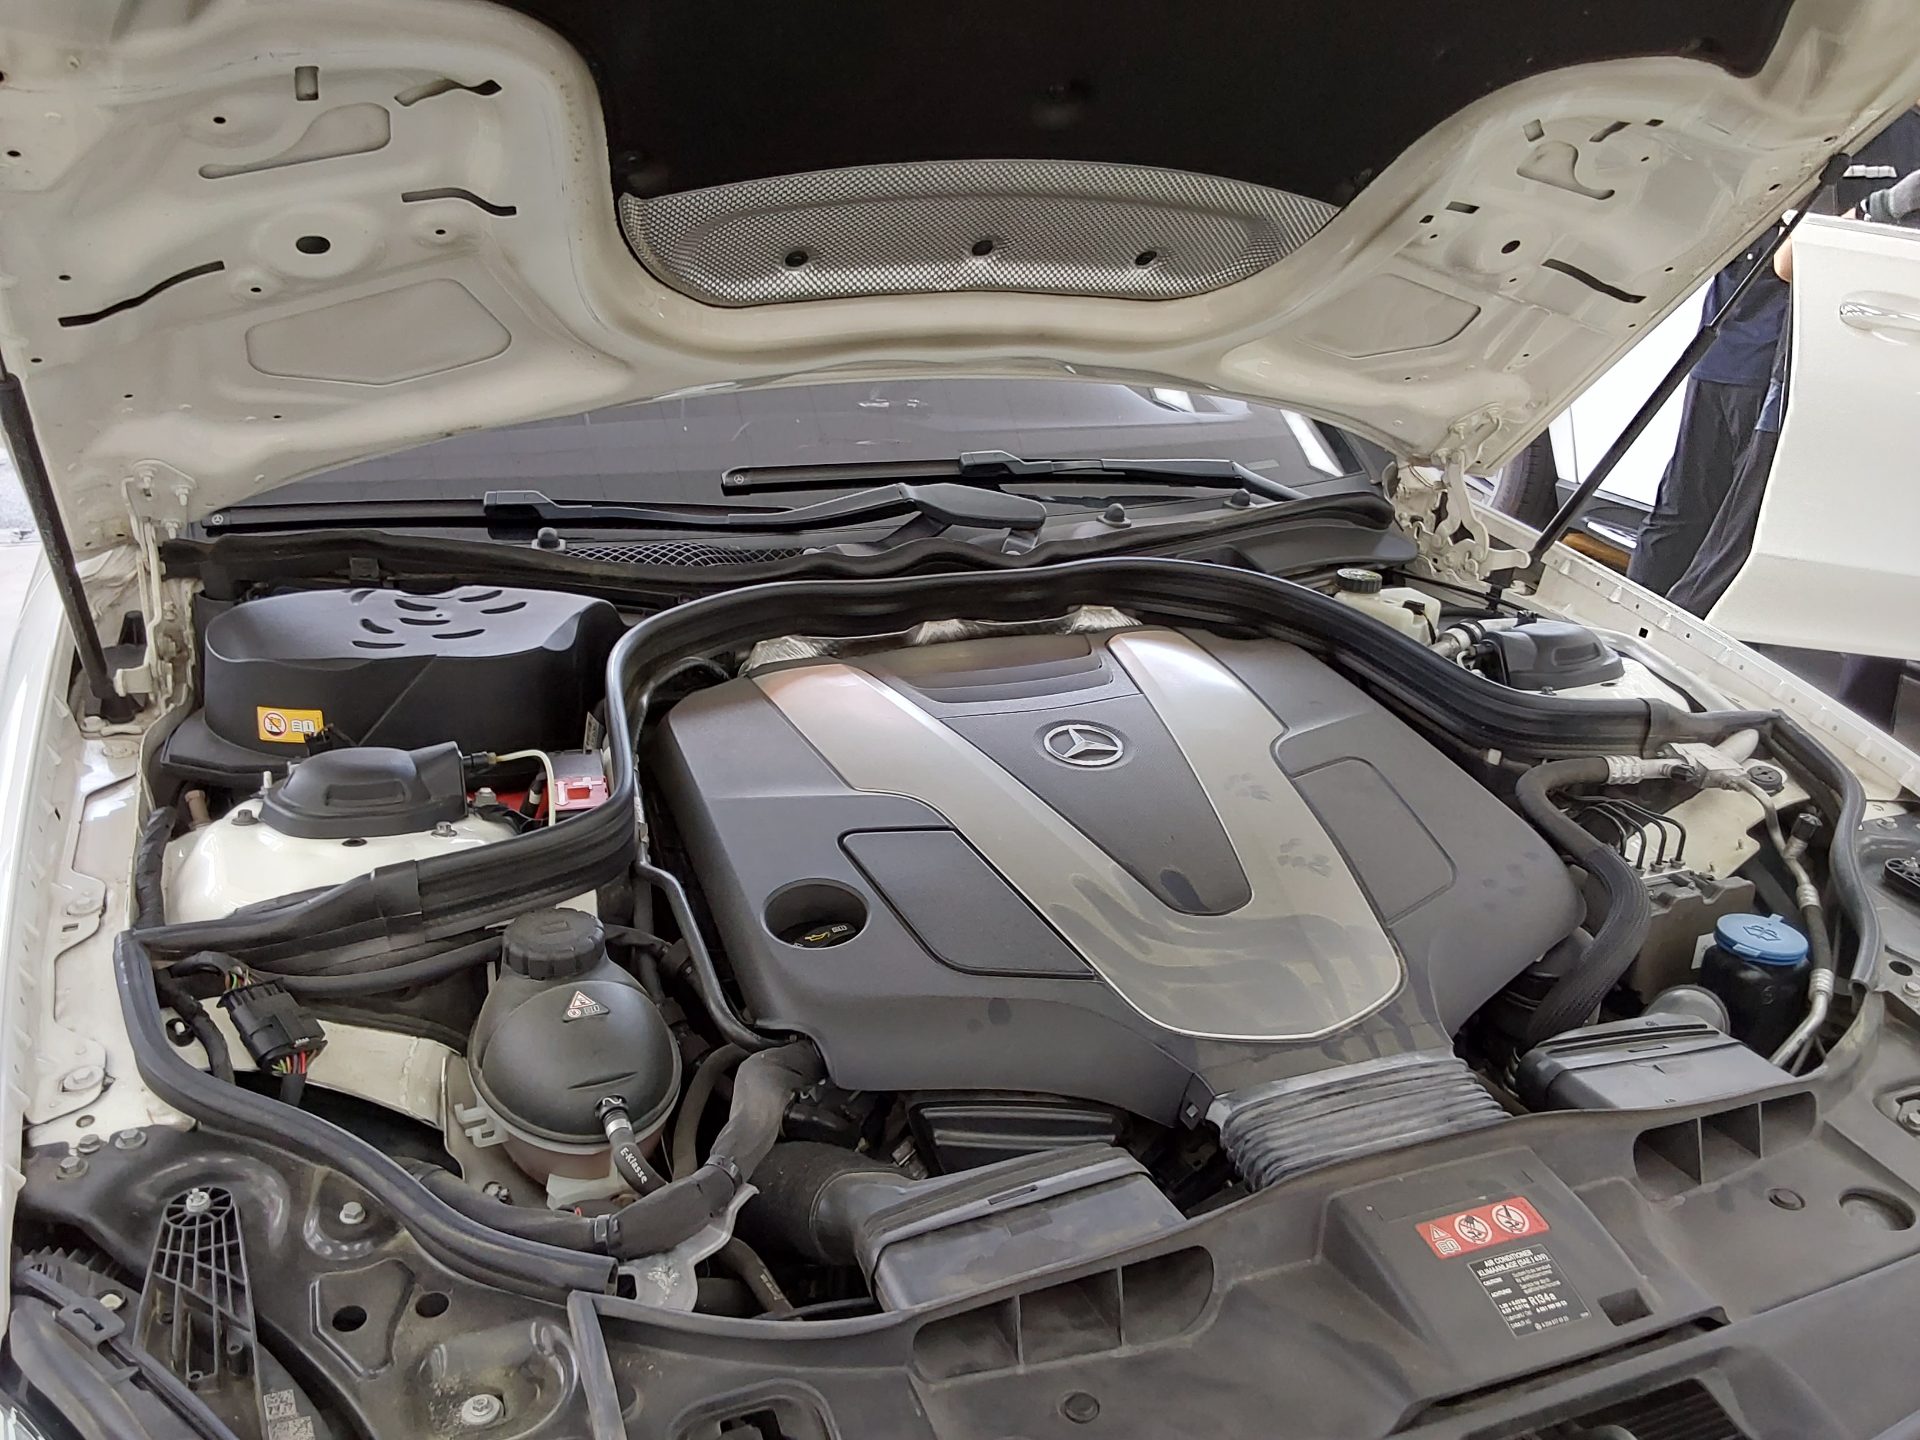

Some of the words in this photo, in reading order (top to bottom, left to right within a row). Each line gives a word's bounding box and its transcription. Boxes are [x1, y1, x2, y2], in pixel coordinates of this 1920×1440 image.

[620, 1147, 648, 1184] E-Klasse
[1484, 1259, 1495, 1267] AIR
[1495, 1249, 1533, 1264] CONDITIONER
[1477, 1260, 1518, 1277] KLIMAANLAGE
[1528, 1292, 1557, 1306] R134a
